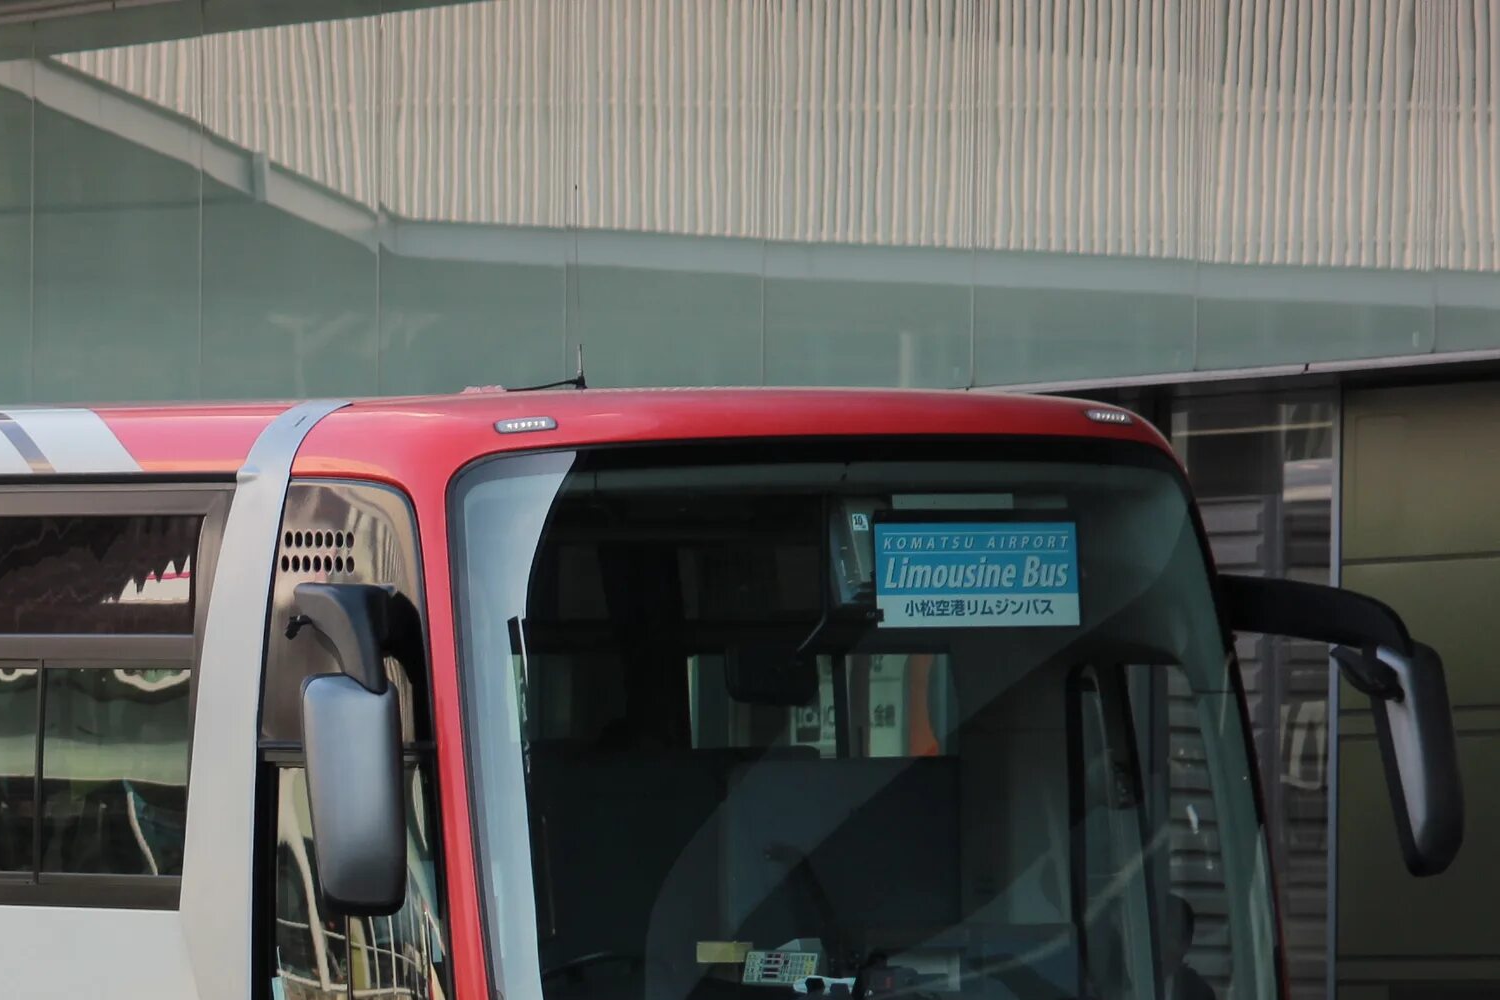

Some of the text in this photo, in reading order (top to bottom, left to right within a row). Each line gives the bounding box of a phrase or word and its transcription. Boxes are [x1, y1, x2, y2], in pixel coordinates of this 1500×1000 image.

[883, 534, 1070, 550] KOMATSU AIRPORT
[884, 555, 1069, 590] Limousine Bus
[904, 598, 1055, 618] 小松空港リムジンバス
